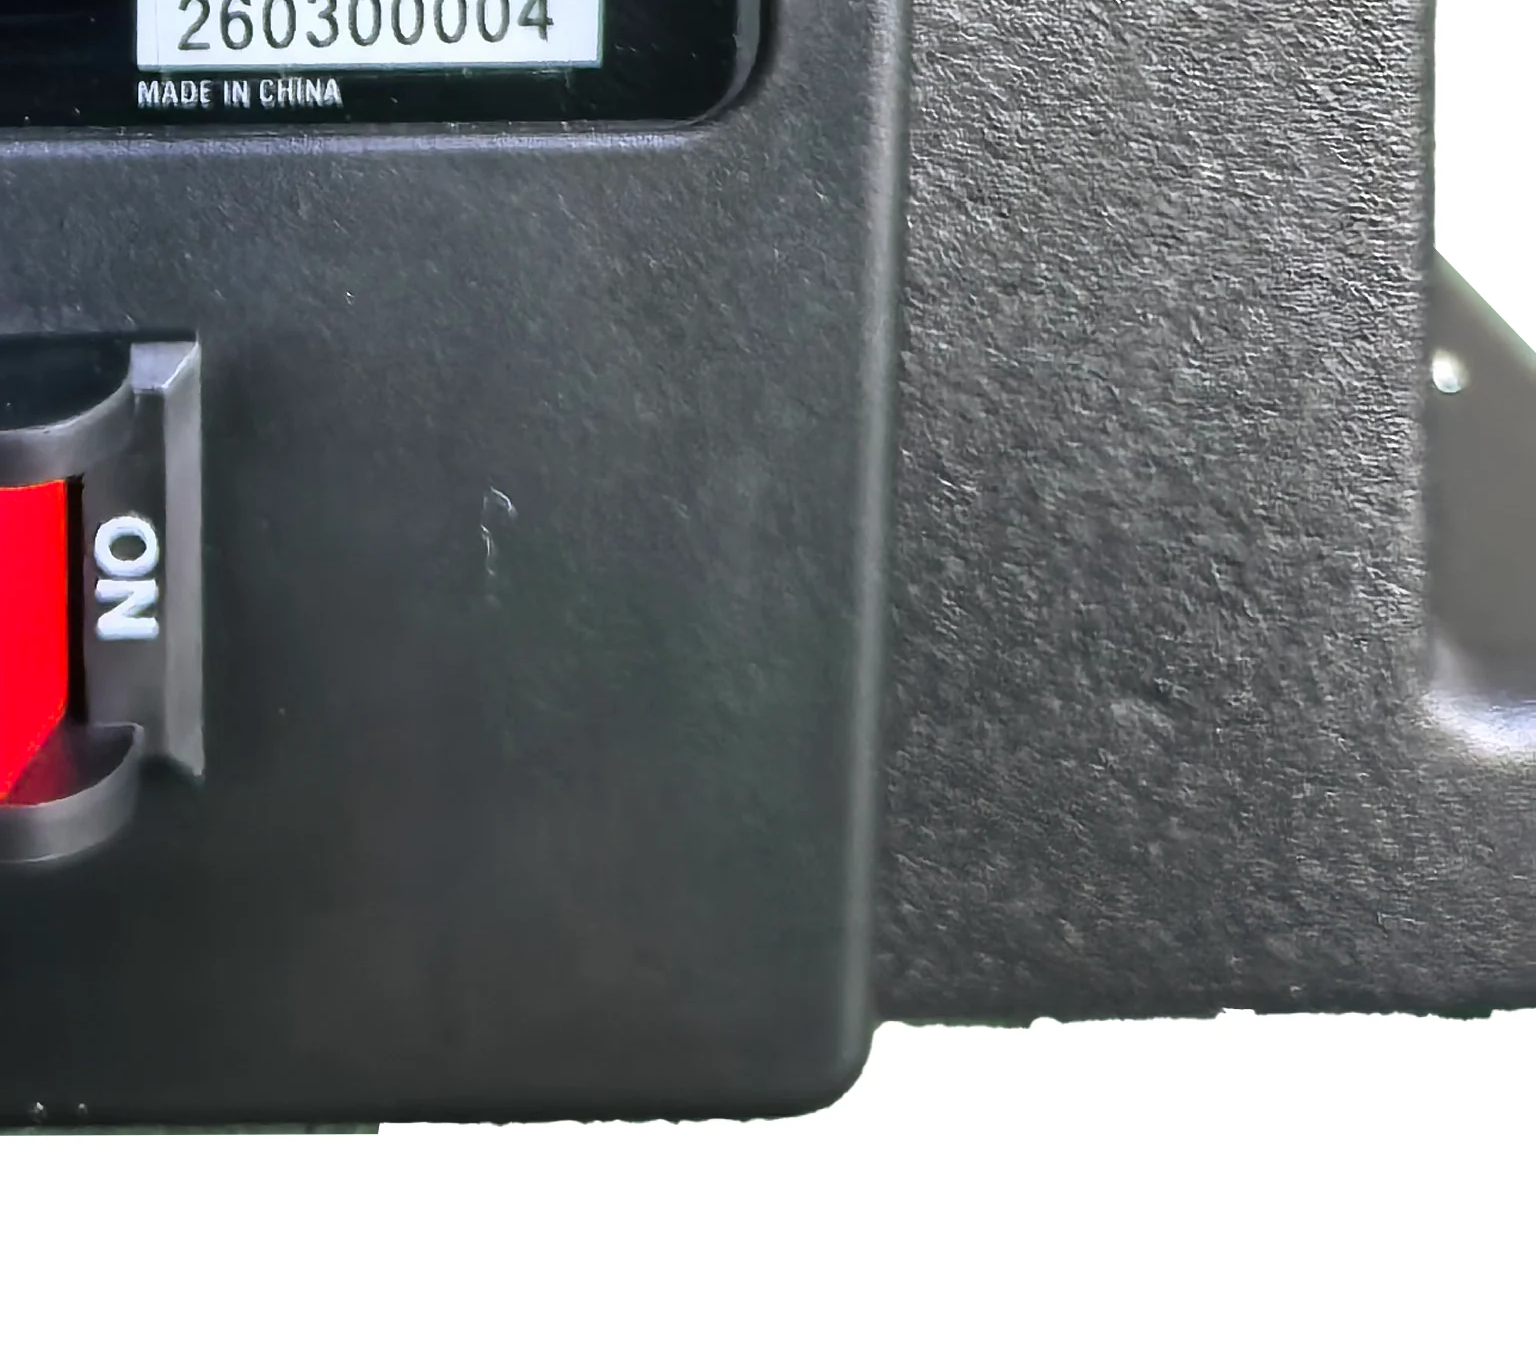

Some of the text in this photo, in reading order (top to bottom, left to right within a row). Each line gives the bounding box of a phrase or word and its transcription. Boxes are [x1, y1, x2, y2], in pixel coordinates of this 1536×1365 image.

[137, 77, 344, 108] MADE IN CHINA
[93, 513, 161, 641] ON
